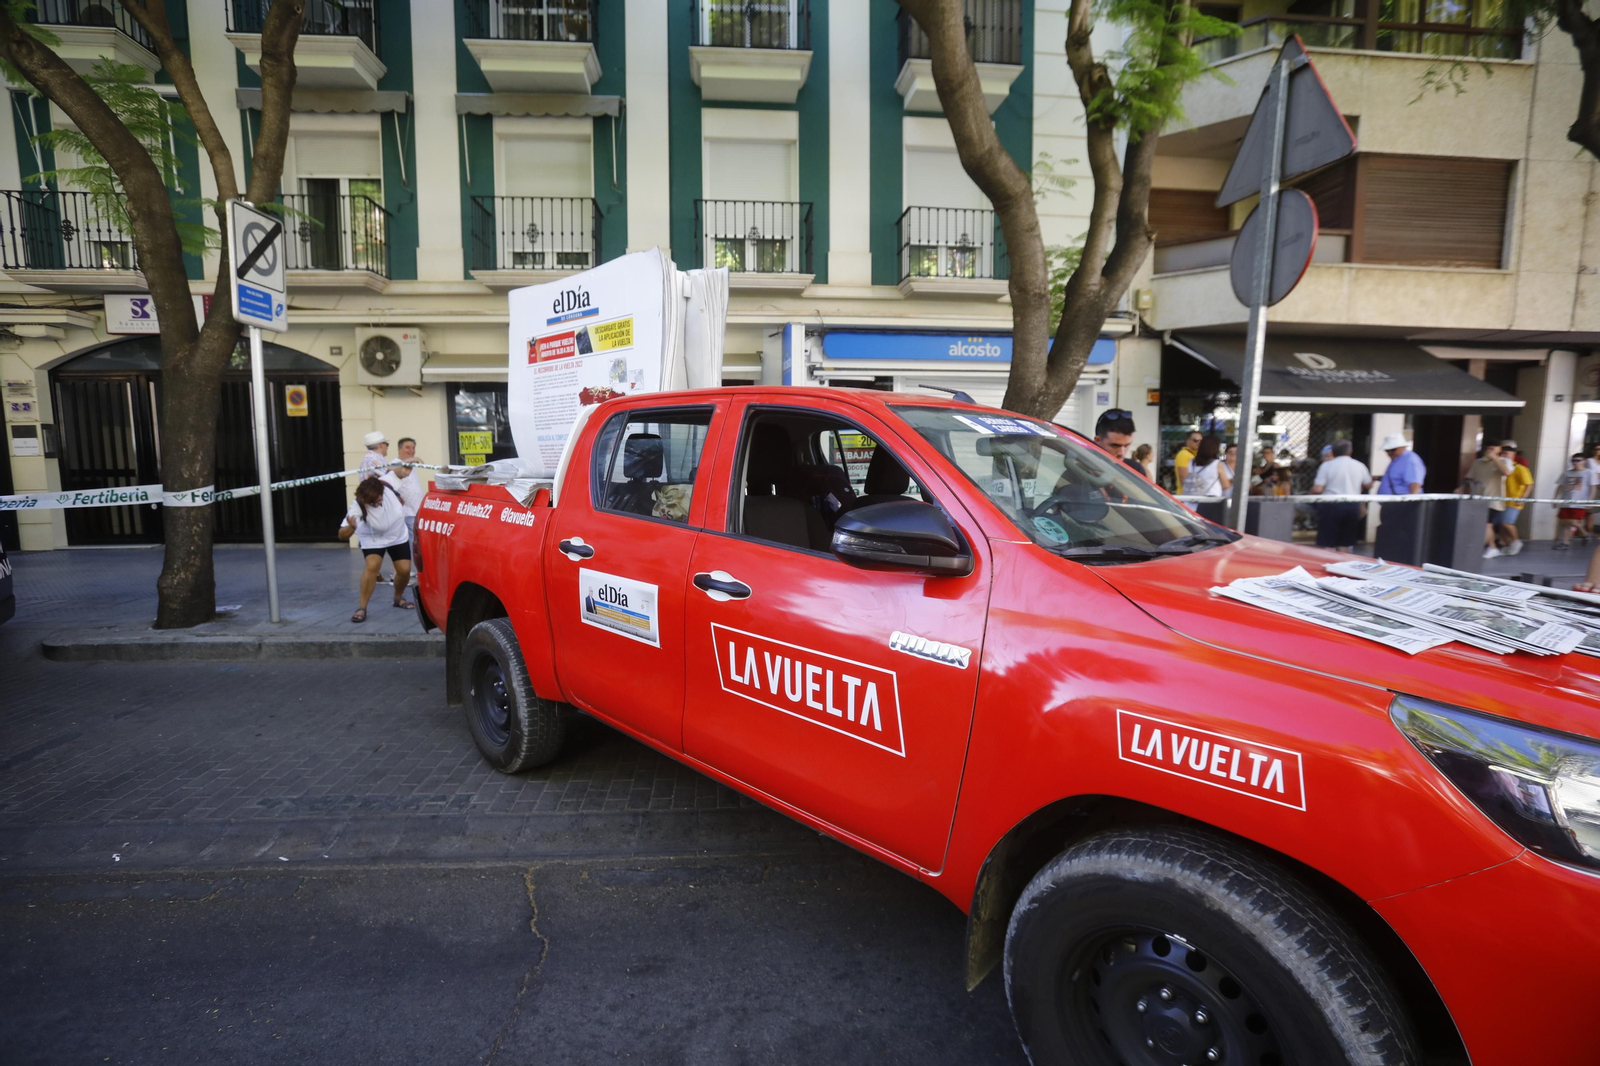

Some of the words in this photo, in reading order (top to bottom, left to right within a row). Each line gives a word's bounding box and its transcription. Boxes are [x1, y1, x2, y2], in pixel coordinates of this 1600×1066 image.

[949, 341, 1001, 357] alcosto
[72, 488, 149, 506] Fertiberia
[456, 501, 493, 519] #LaVuelta22
[500, 507, 535, 527] @lavuelta
[890, 632, 971, 668] HILUX
[729, 641, 761, 689] LA
[764, 651, 882, 732] VUELTA
[1131, 723, 1163, 761] LA
[1171, 732, 1285, 794] VUELTA
